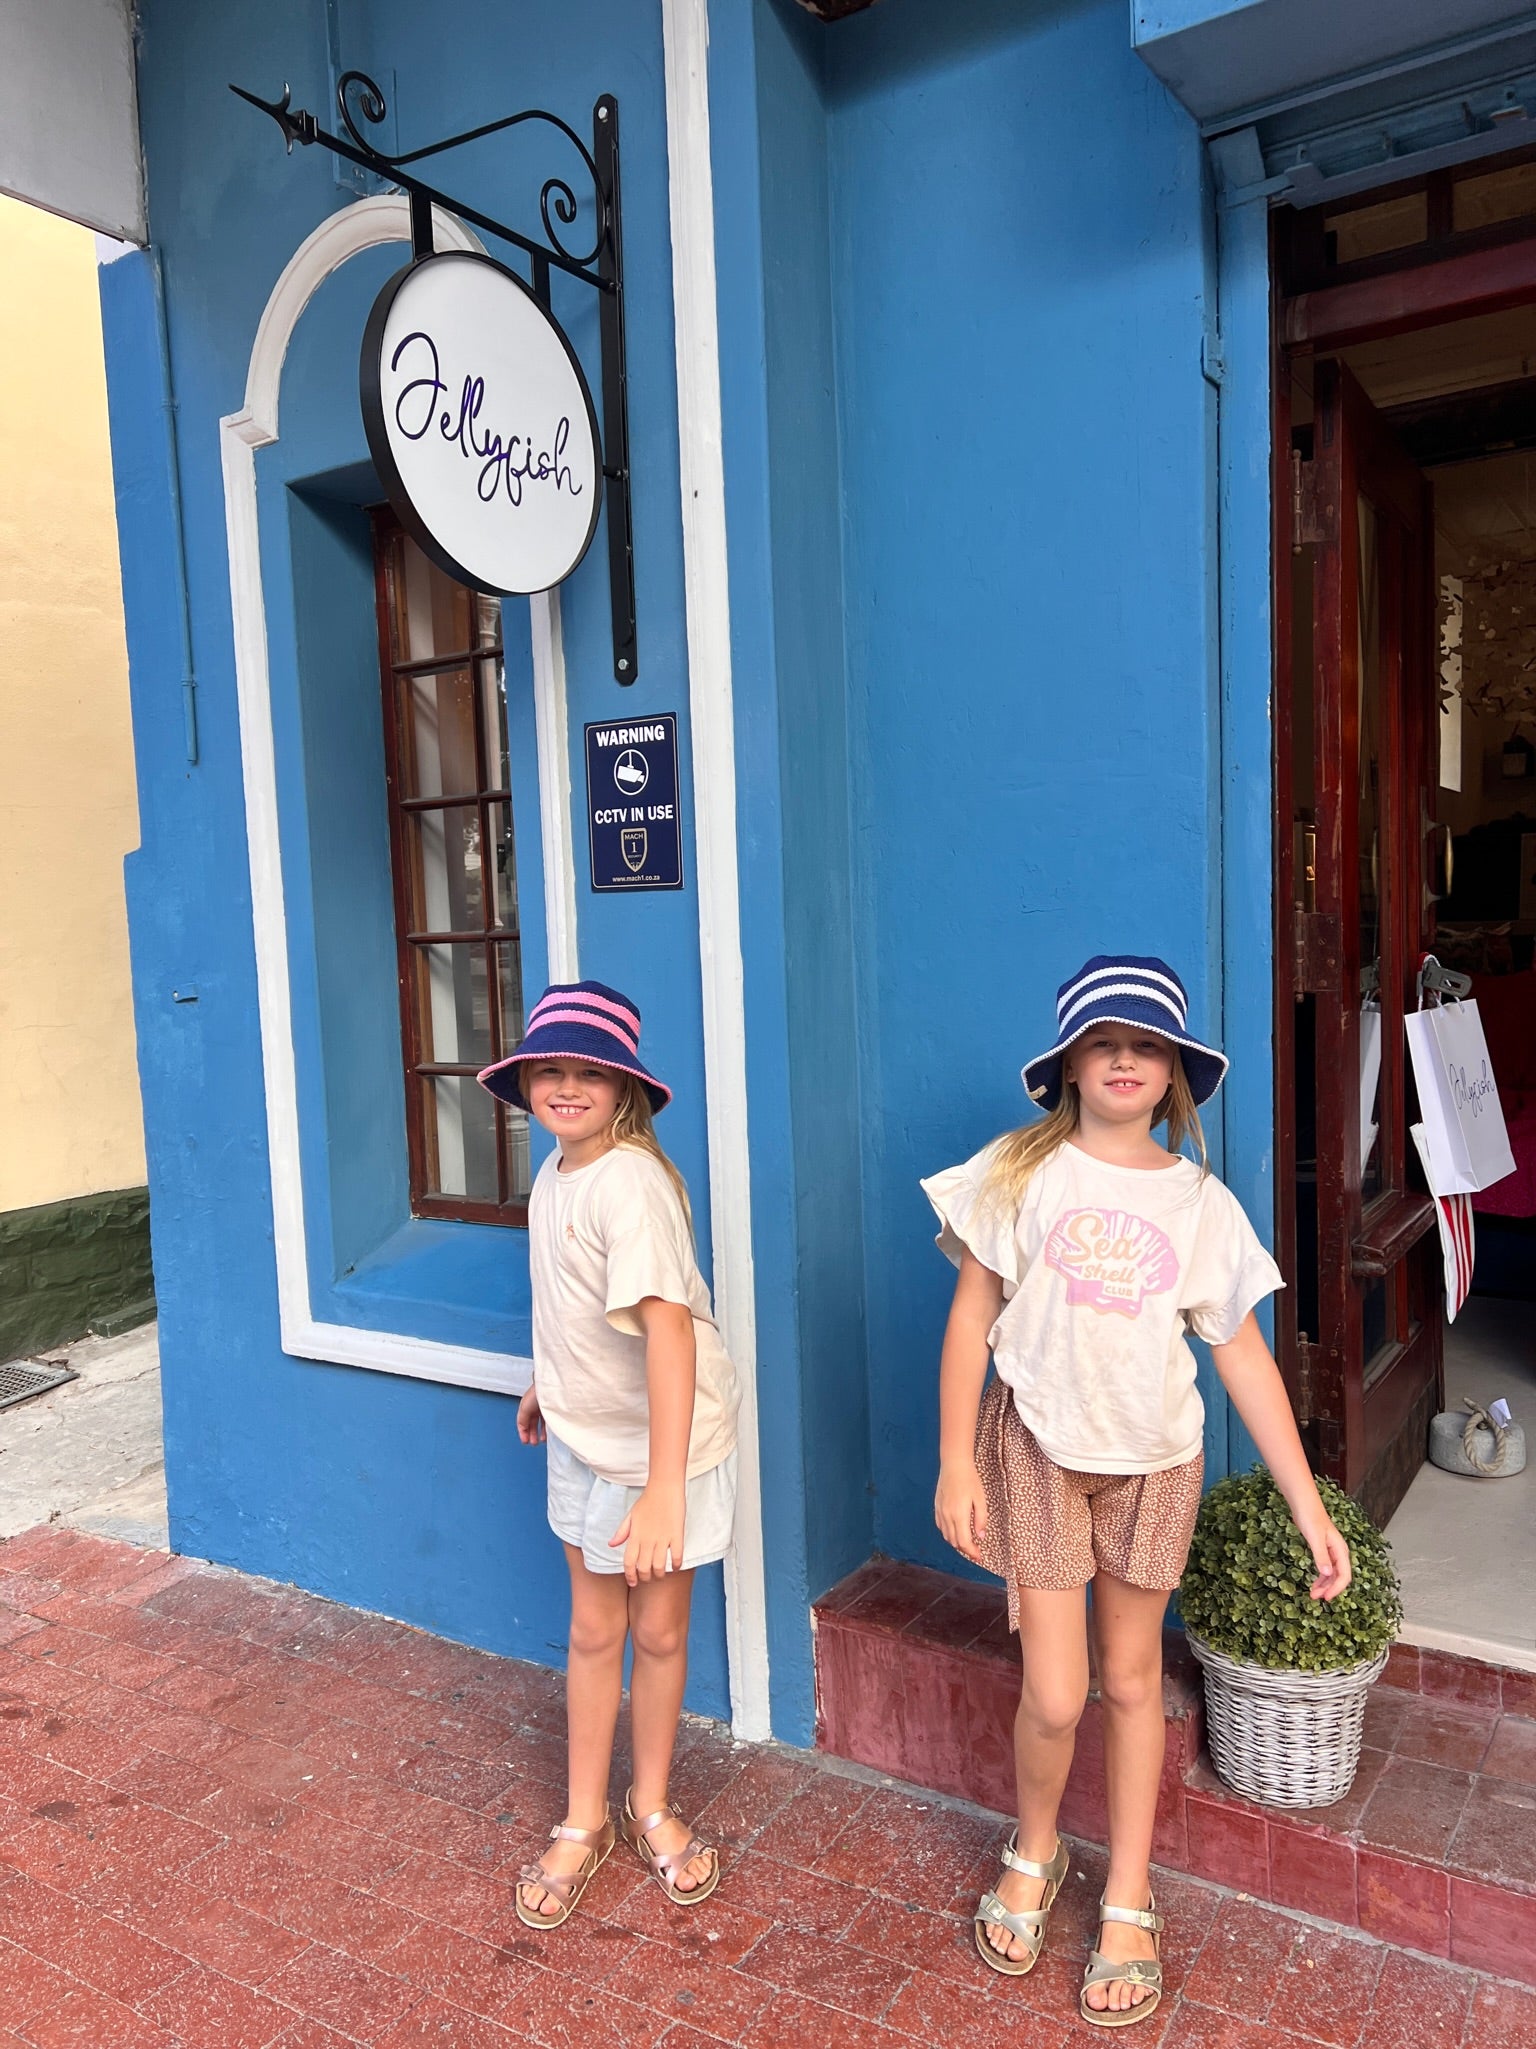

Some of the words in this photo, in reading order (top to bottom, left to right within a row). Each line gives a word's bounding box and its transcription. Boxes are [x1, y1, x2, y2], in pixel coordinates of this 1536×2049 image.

[391, 332, 582, 506] Jellyfish
[596, 725, 665, 747] WARNING
[595, 809, 627, 824] CCTV
[631, 806, 644, 822] IN
[647, 805, 673, 820] USE
[624, 833, 644, 841] MACH
[632, 841, 637, 853] 1
[1061, 1214, 1141, 1263] Sea
[1104, 1286, 1133, 1296] CLUB
